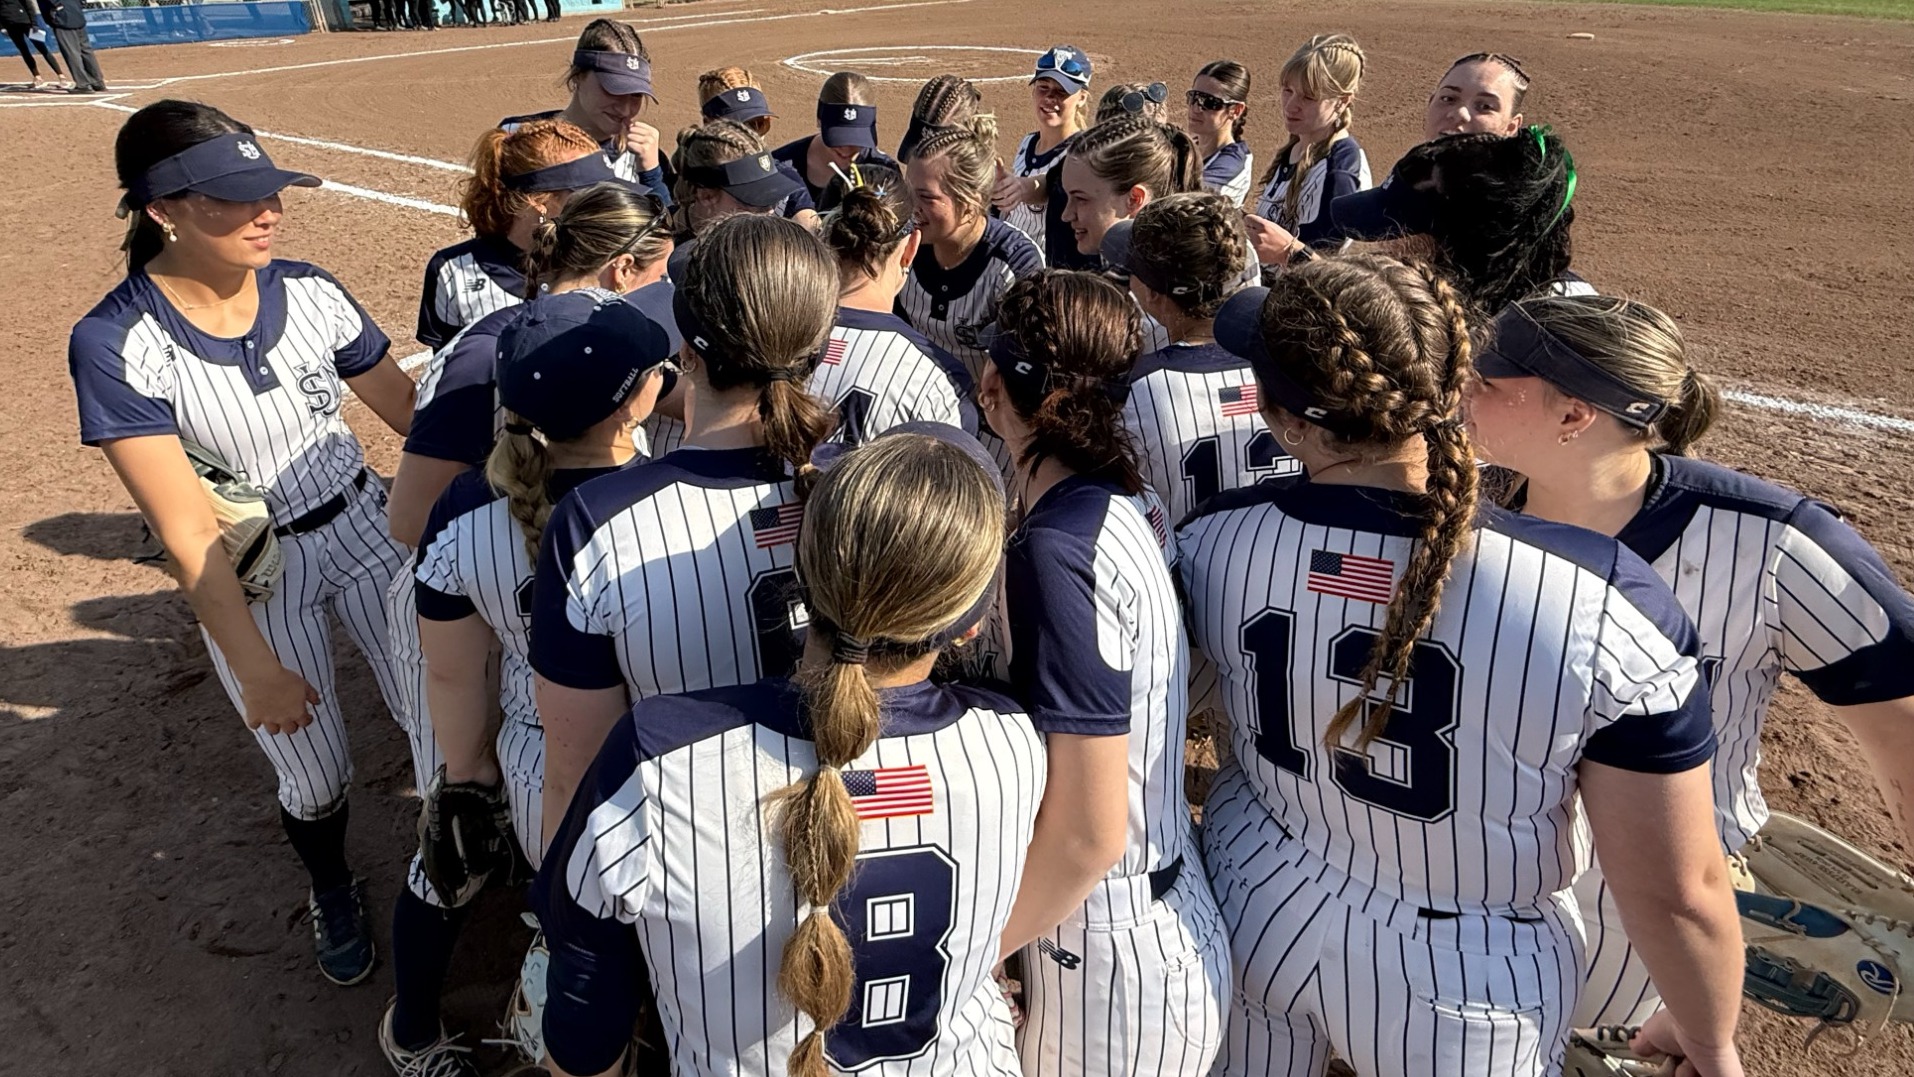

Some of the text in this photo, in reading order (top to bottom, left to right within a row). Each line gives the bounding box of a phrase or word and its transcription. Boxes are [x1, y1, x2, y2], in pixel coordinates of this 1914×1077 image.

[612, 367, 639, 403] SOFTBALL
[1239, 607, 1464, 824] 13
[824, 844, 960, 1072] 8
